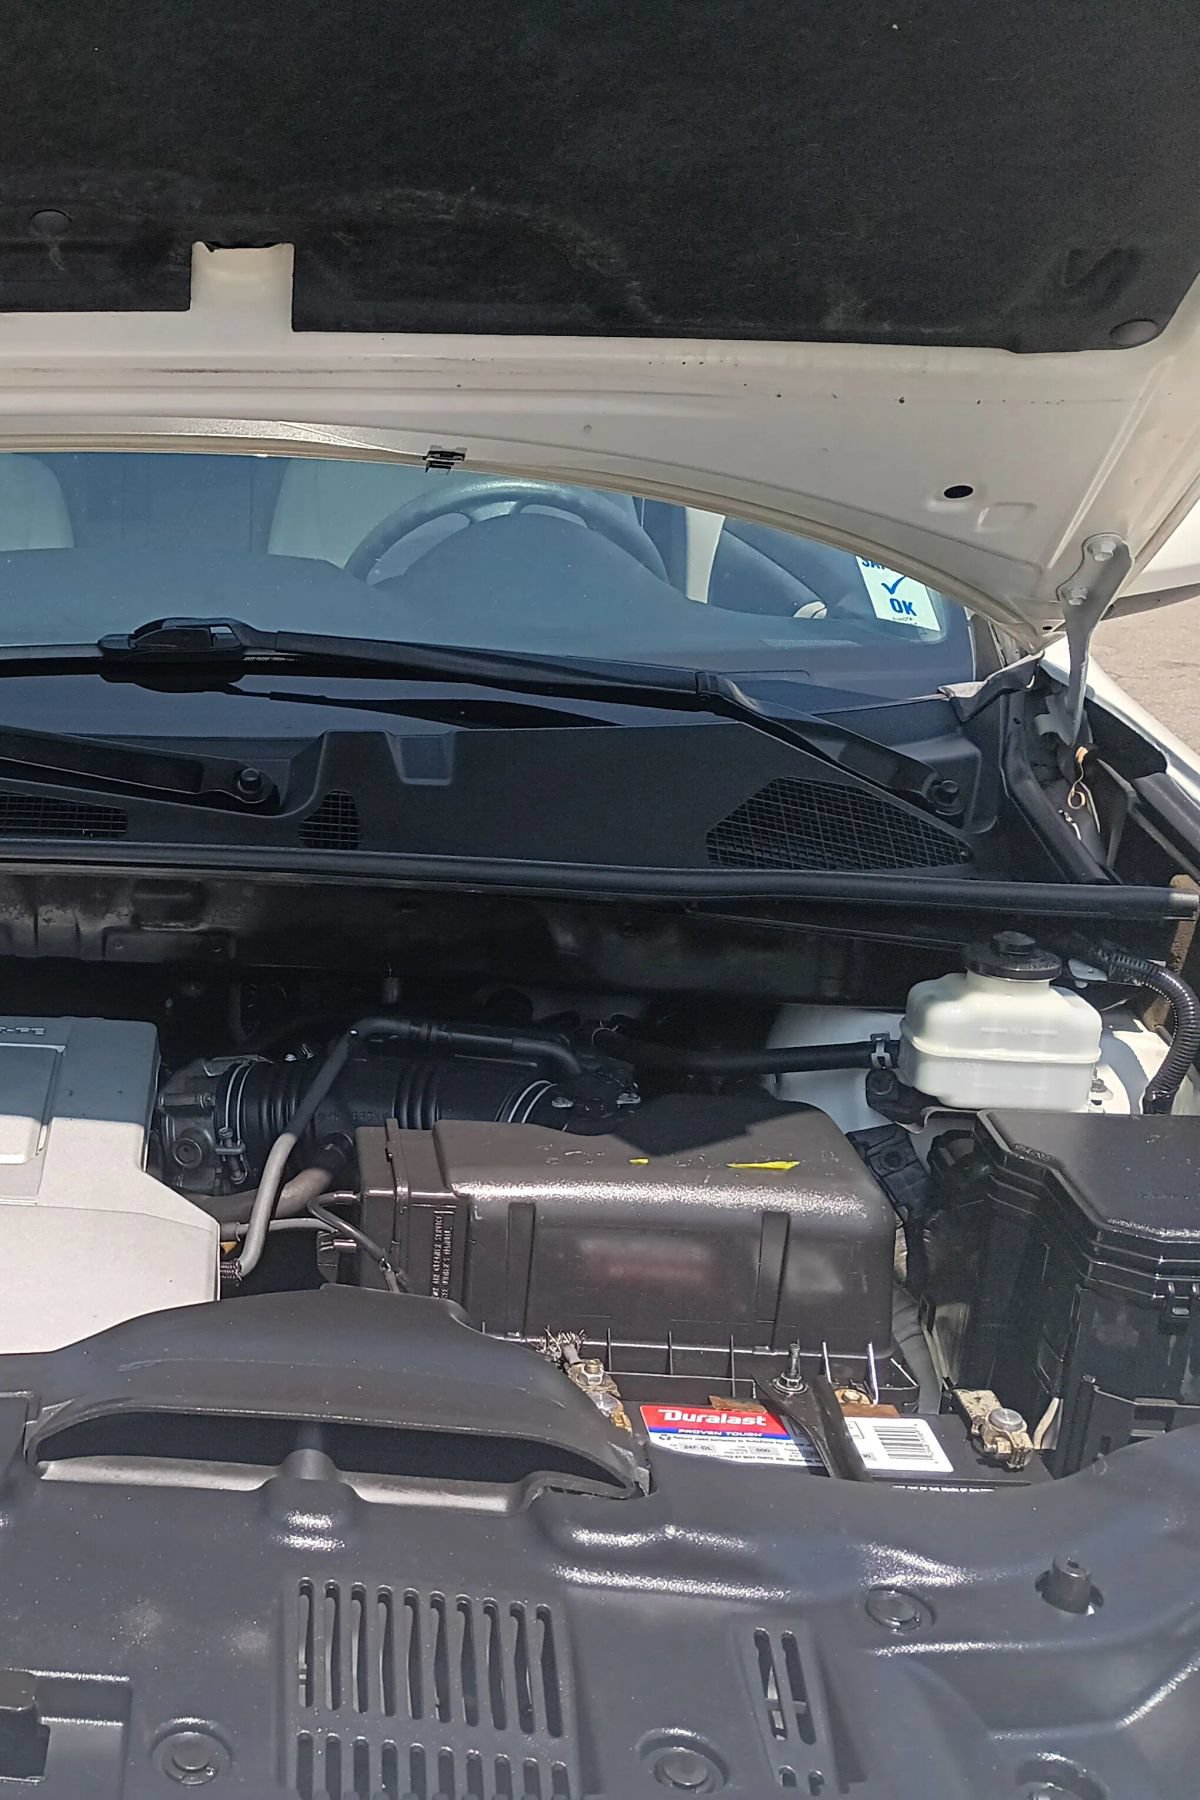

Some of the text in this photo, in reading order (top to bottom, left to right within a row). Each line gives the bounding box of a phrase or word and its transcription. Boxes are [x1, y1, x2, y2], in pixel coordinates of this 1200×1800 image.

[889, 598, 917, 616] OK
[657, 1408, 767, 1426] Duralast
[678, 1428, 763, 1438] PROVEN TOUGH
